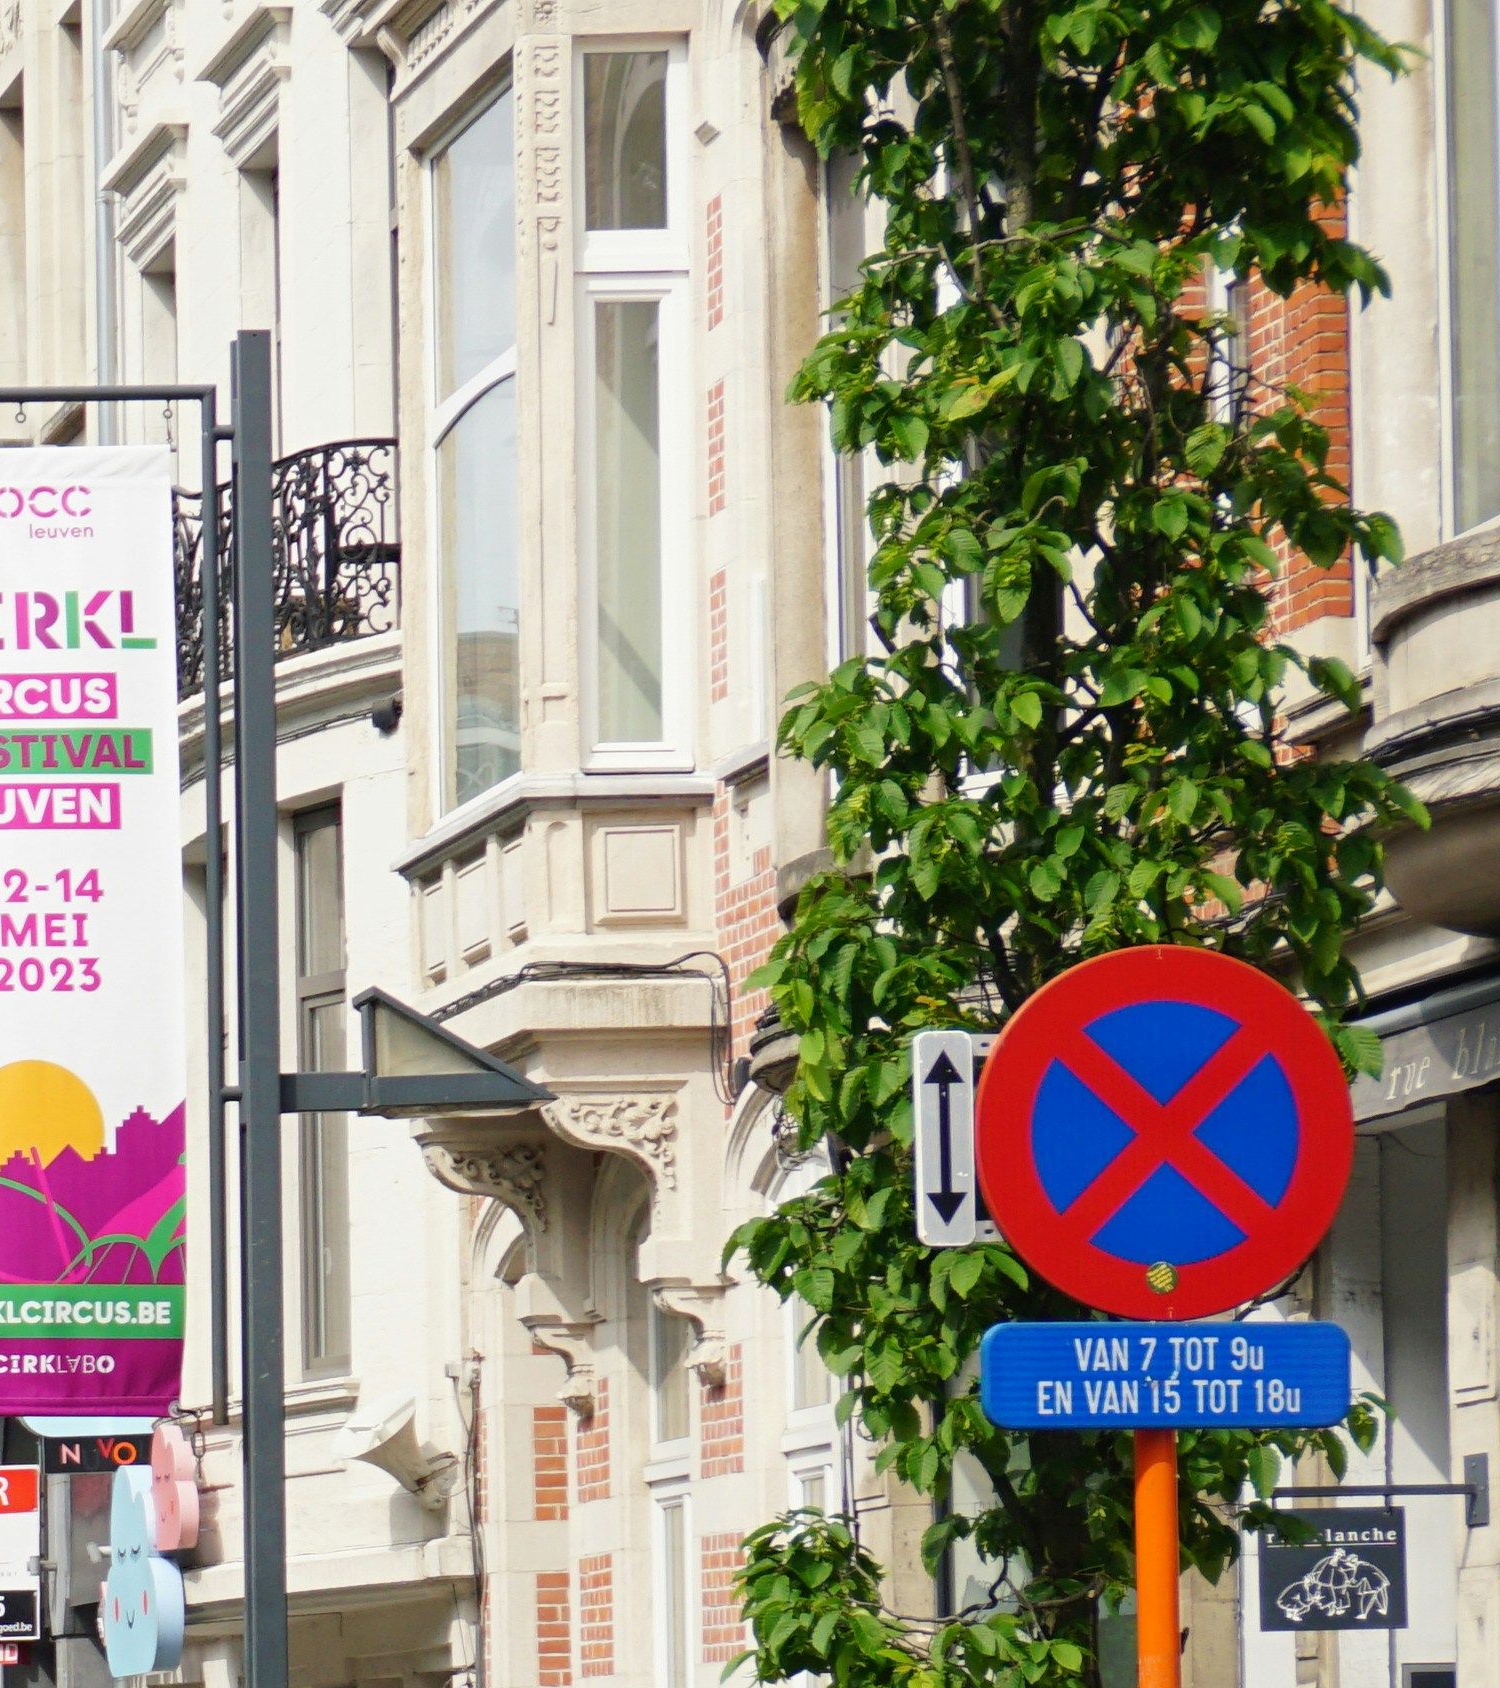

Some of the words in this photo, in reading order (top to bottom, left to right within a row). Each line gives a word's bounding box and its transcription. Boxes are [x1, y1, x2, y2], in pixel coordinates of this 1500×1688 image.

[28, 523, 94, 539] leuven
[0, 912, 89, 948] MEI
[1385, 1056, 1431, 1100] rue
[1452, 1022, 1500, 1080] bla
[1074, 1338, 1129, 1372] VAN
[1140, 1337, 1157, 1372] 7
[1169, 1337, 1219, 1372] TOT
[1230, 1336, 1264, 1371] 9u
[1037, 1380, 1072, 1415] EN
[1083, 1380, 1139, 1414] VAN
[1150, 1379, 1181, 1414] 15
[1192, 1379, 1243, 1413] TOT
[1254, 1379, 1301, 1413] 18u
[1313, 1527, 1398, 1543] lanche
